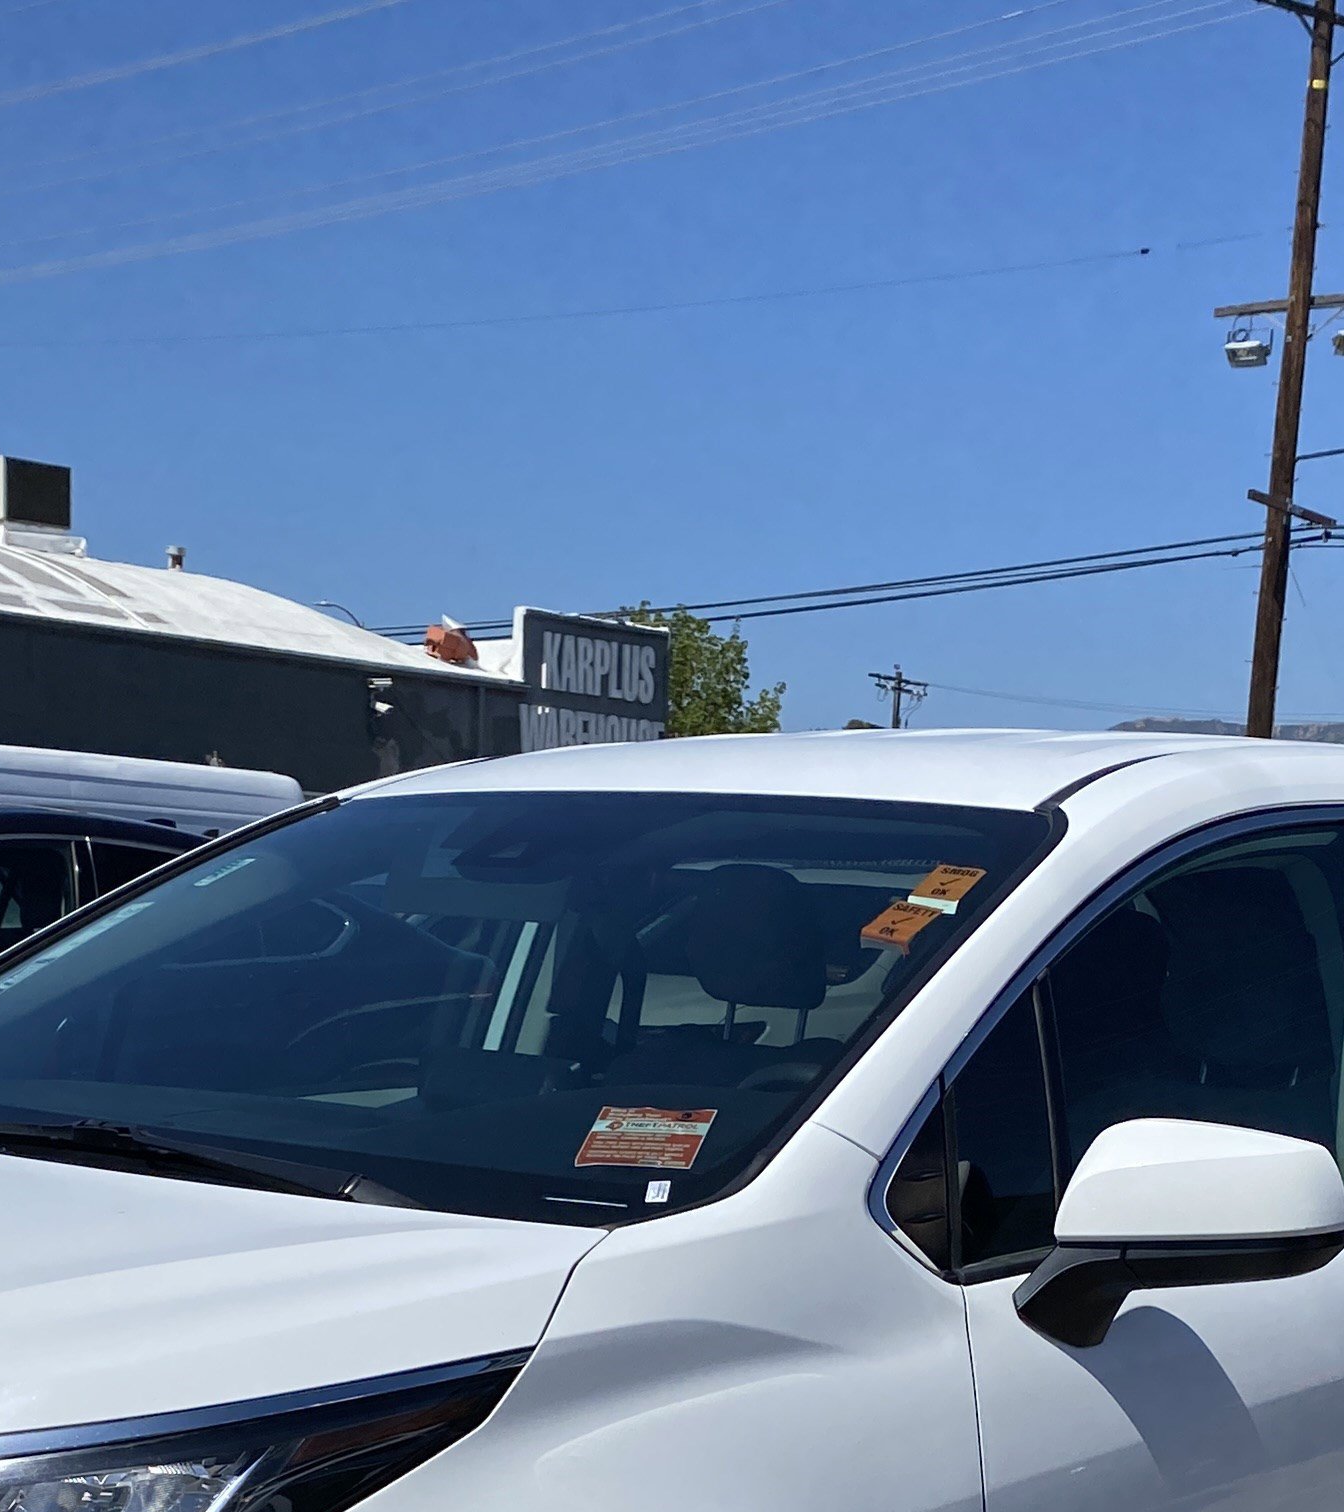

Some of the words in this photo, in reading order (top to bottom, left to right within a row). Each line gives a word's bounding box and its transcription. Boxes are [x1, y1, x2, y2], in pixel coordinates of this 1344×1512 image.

[542, 631, 655, 703] KARPLUS
[940, 868, 979, 877] SMOG
[930, 888, 949, 896] OK
[893, 903, 939, 917] SAFETY
[879, 927, 898, 938] OK
